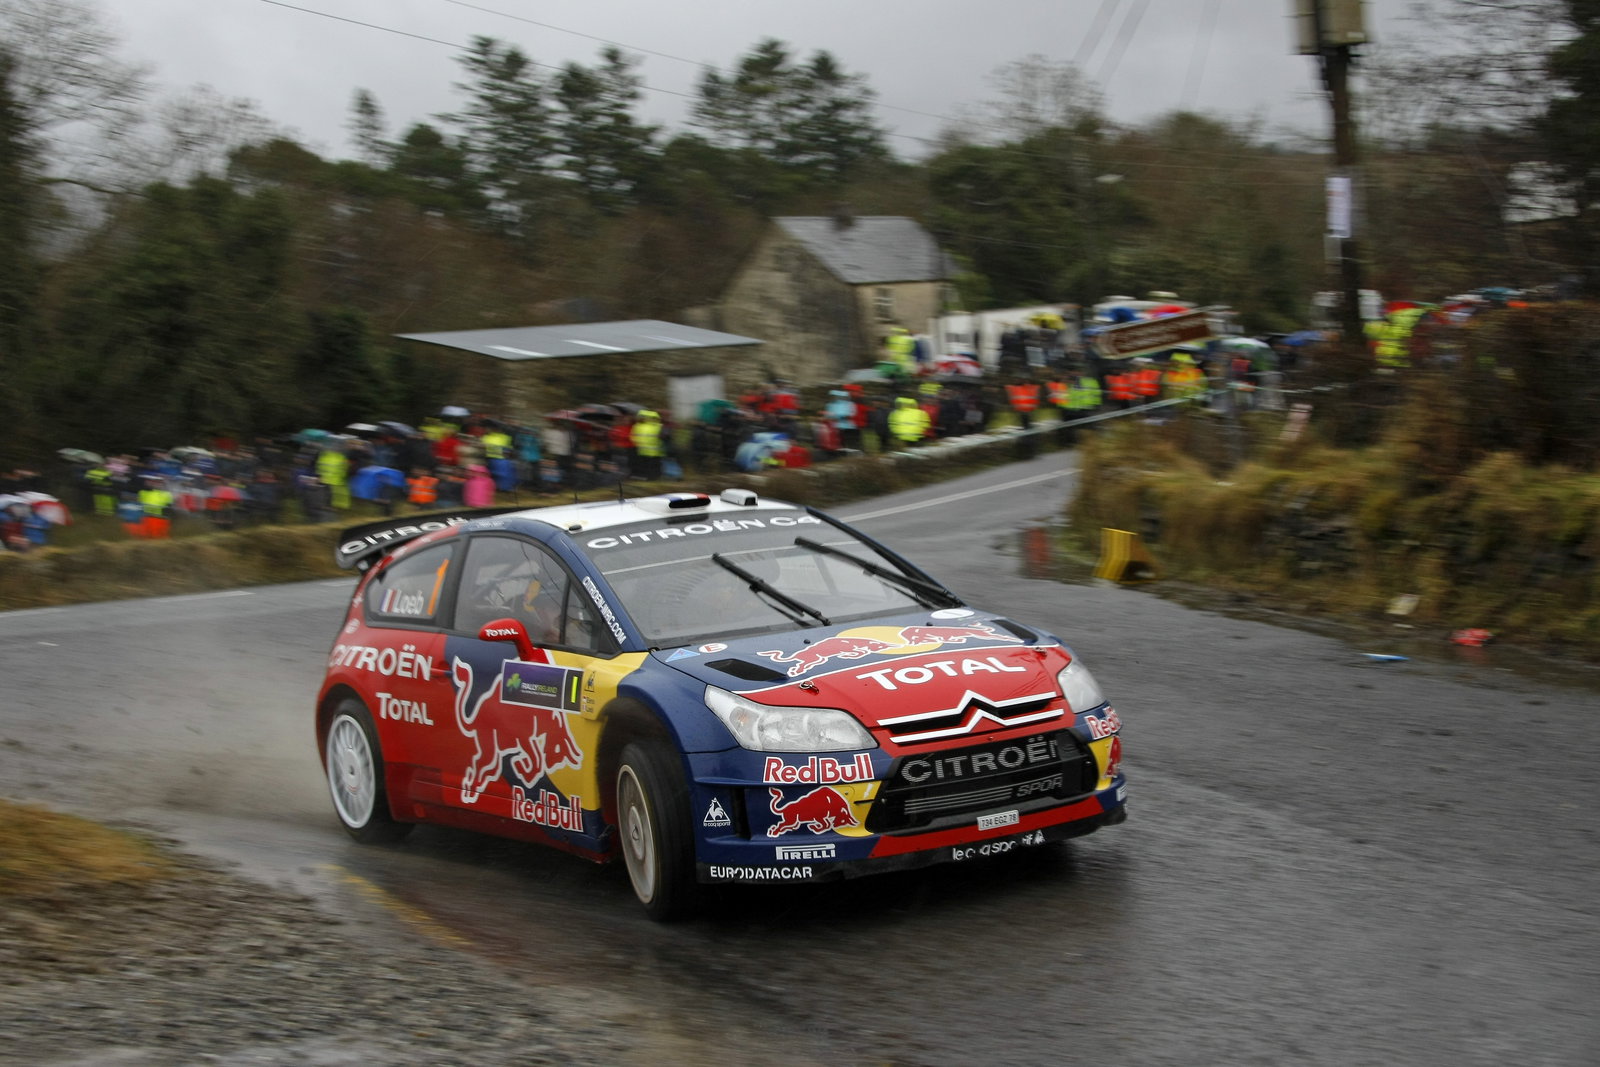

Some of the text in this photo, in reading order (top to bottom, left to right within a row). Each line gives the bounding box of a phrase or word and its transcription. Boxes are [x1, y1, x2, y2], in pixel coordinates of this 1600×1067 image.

[587, 517, 767, 549] CITROËN
[392, 589, 425, 615] Loeb
[484, 627, 519, 637] TOTAL
[329, 643, 433, 682] CITROËN
[856, 656, 1027, 691] TOTAL
[375, 691, 435, 726] TOTAL
[775, 843, 836, 860] PIRELLI
